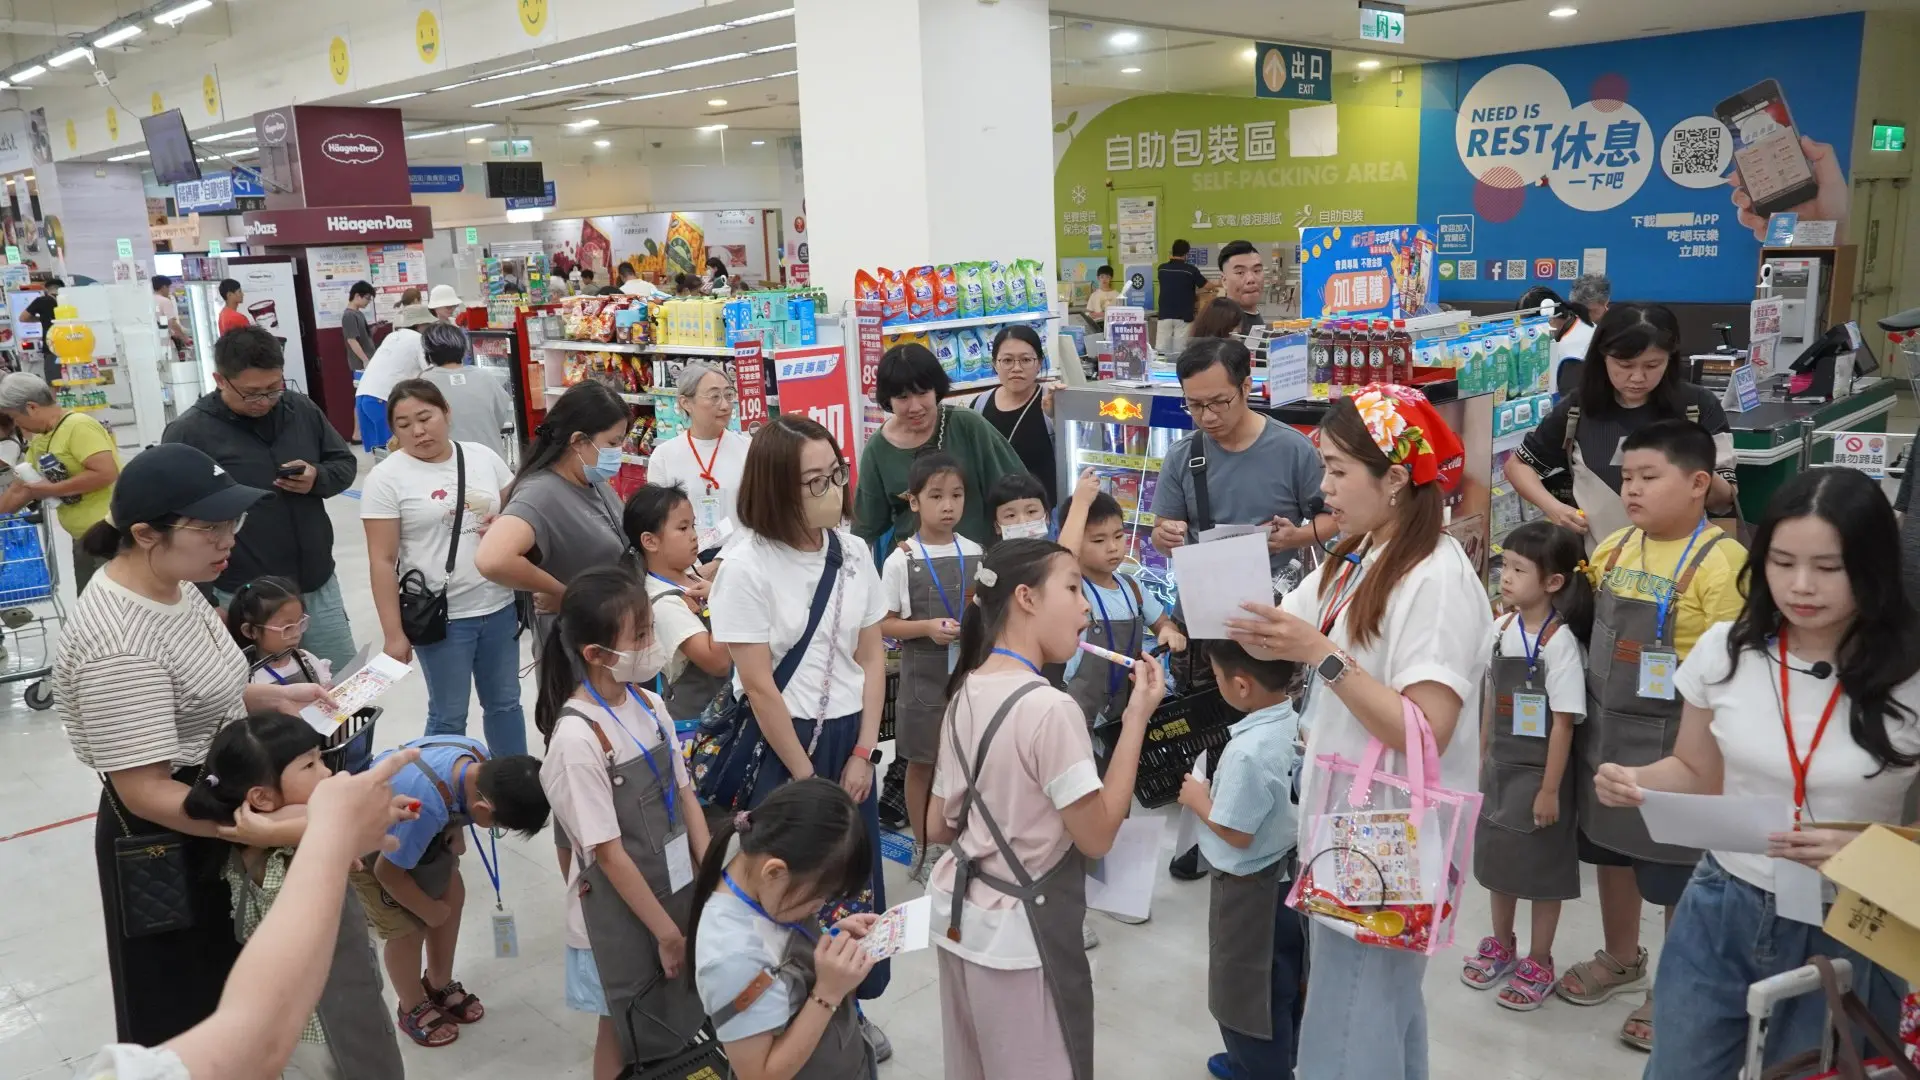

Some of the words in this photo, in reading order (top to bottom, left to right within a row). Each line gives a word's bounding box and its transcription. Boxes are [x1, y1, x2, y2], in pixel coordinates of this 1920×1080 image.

[1291, 51, 1322, 80] 出口
[1298, 83, 1315, 94] EXIT
[1471, 106, 1517, 123] NEED
[1523, 104, 1540, 119] IS
[1106, 121, 1276, 171] 自助包裝區
[1466, 123, 1553, 157] REST
[1551, 120, 1640, 170] 休息
[1192, 164, 1338, 191] SELF-PACKING
[1346, 161, 1408, 183] AREA
[1568, 171, 1625, 190] 一下吧
[327, 215, 412, 232] Häagen-Dazs
[1319, 210, 1364, 223] 自助包裝
[1694, 213, 1720, 225] APP
[1667, 229, 1719, 242] 吃喝玩樂
[1679, 244, 1718, 257] 立即知
[1333, 275, 1384, 307] 加價購
[782, 360, 827, 376] 會員專屬
[1835, 454, 1883, 464] 請勿跨越
